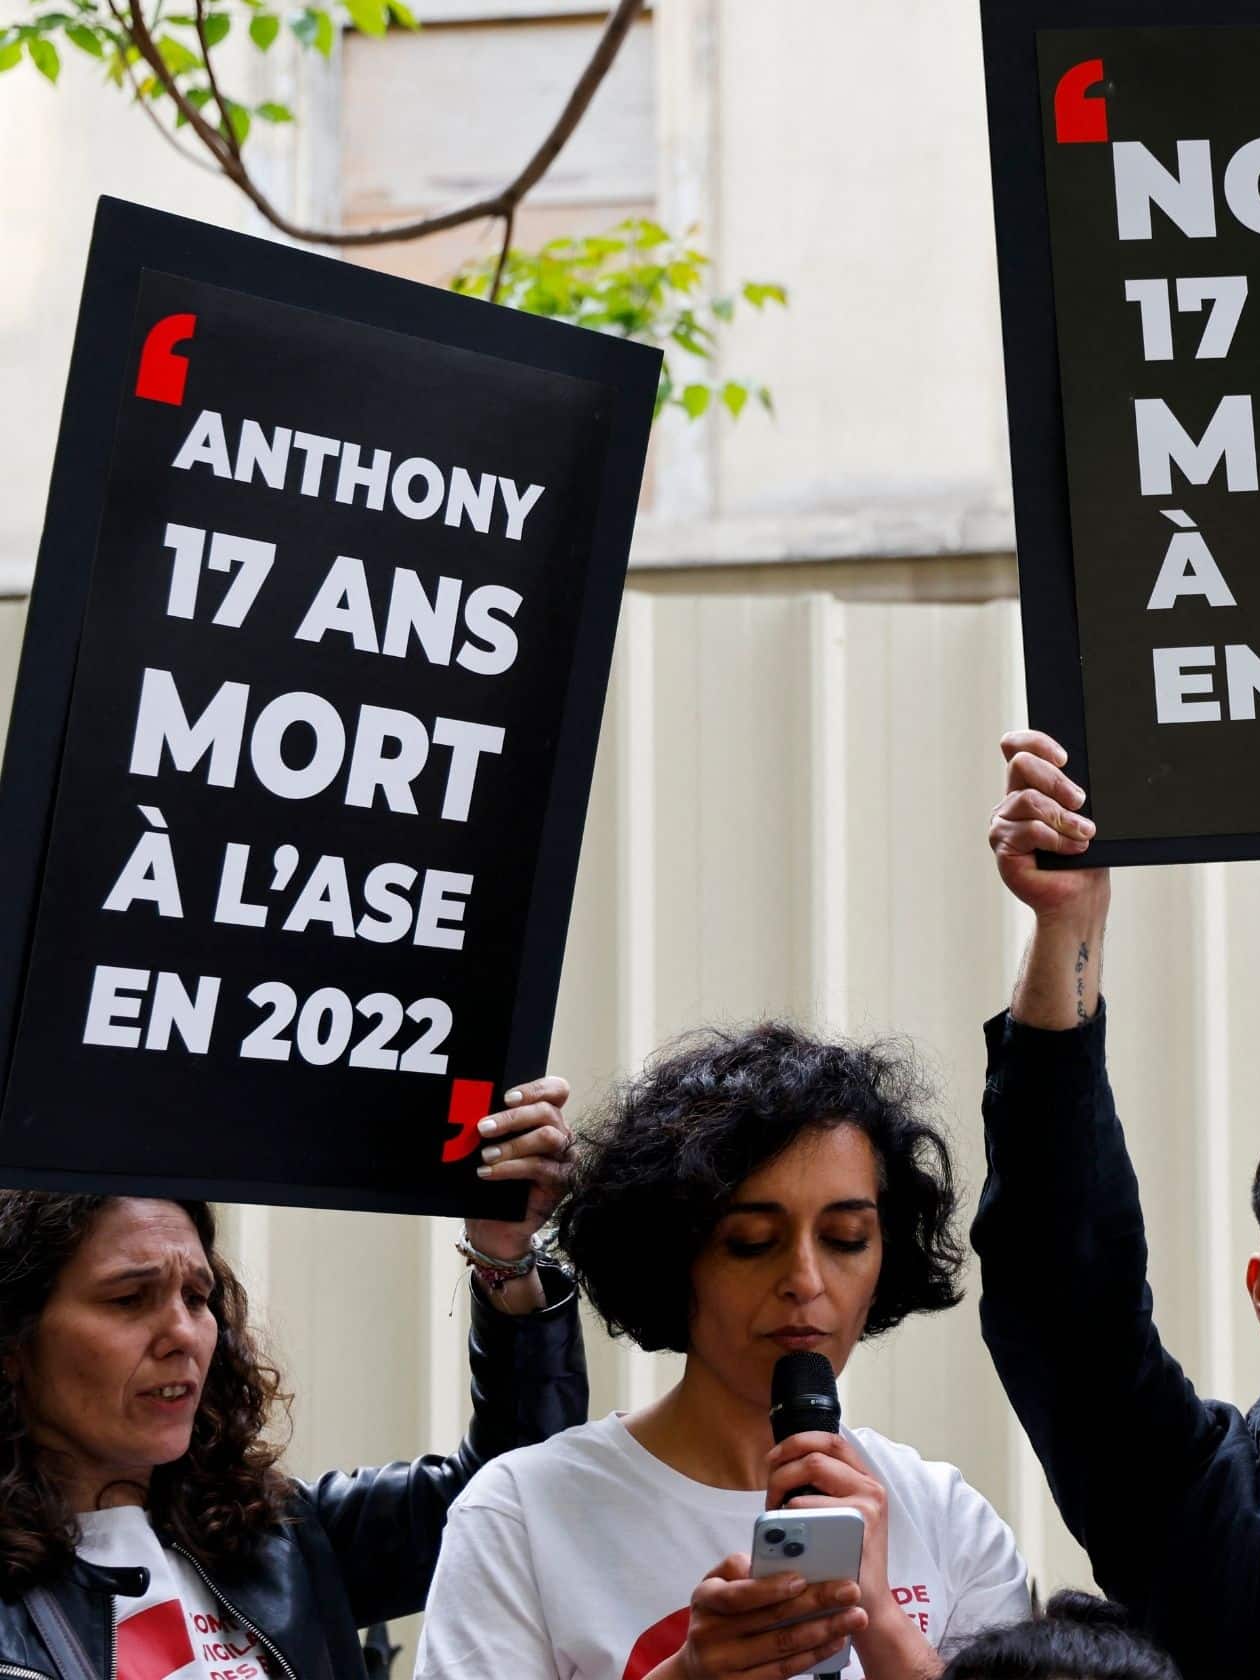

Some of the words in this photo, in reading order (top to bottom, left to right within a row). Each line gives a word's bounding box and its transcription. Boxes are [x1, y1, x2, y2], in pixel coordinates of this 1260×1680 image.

[1124, 276, 1249, 360] 17
[172, 409, 546, 541] ANTHONY
[164, 523, 277, 629] 17
[294, 555, 523, 676] ANS
[1146, 509, 1238, 609] À
[130, 667, 506, 823] MORT
[102, 804, 184, 919] À
[214, 843, 474, 951] L’ASE
[83, 964, 222, 1055] EN
[239, 981, 453, 1075] 2022
[890, 1585, 930, 1606] DE
